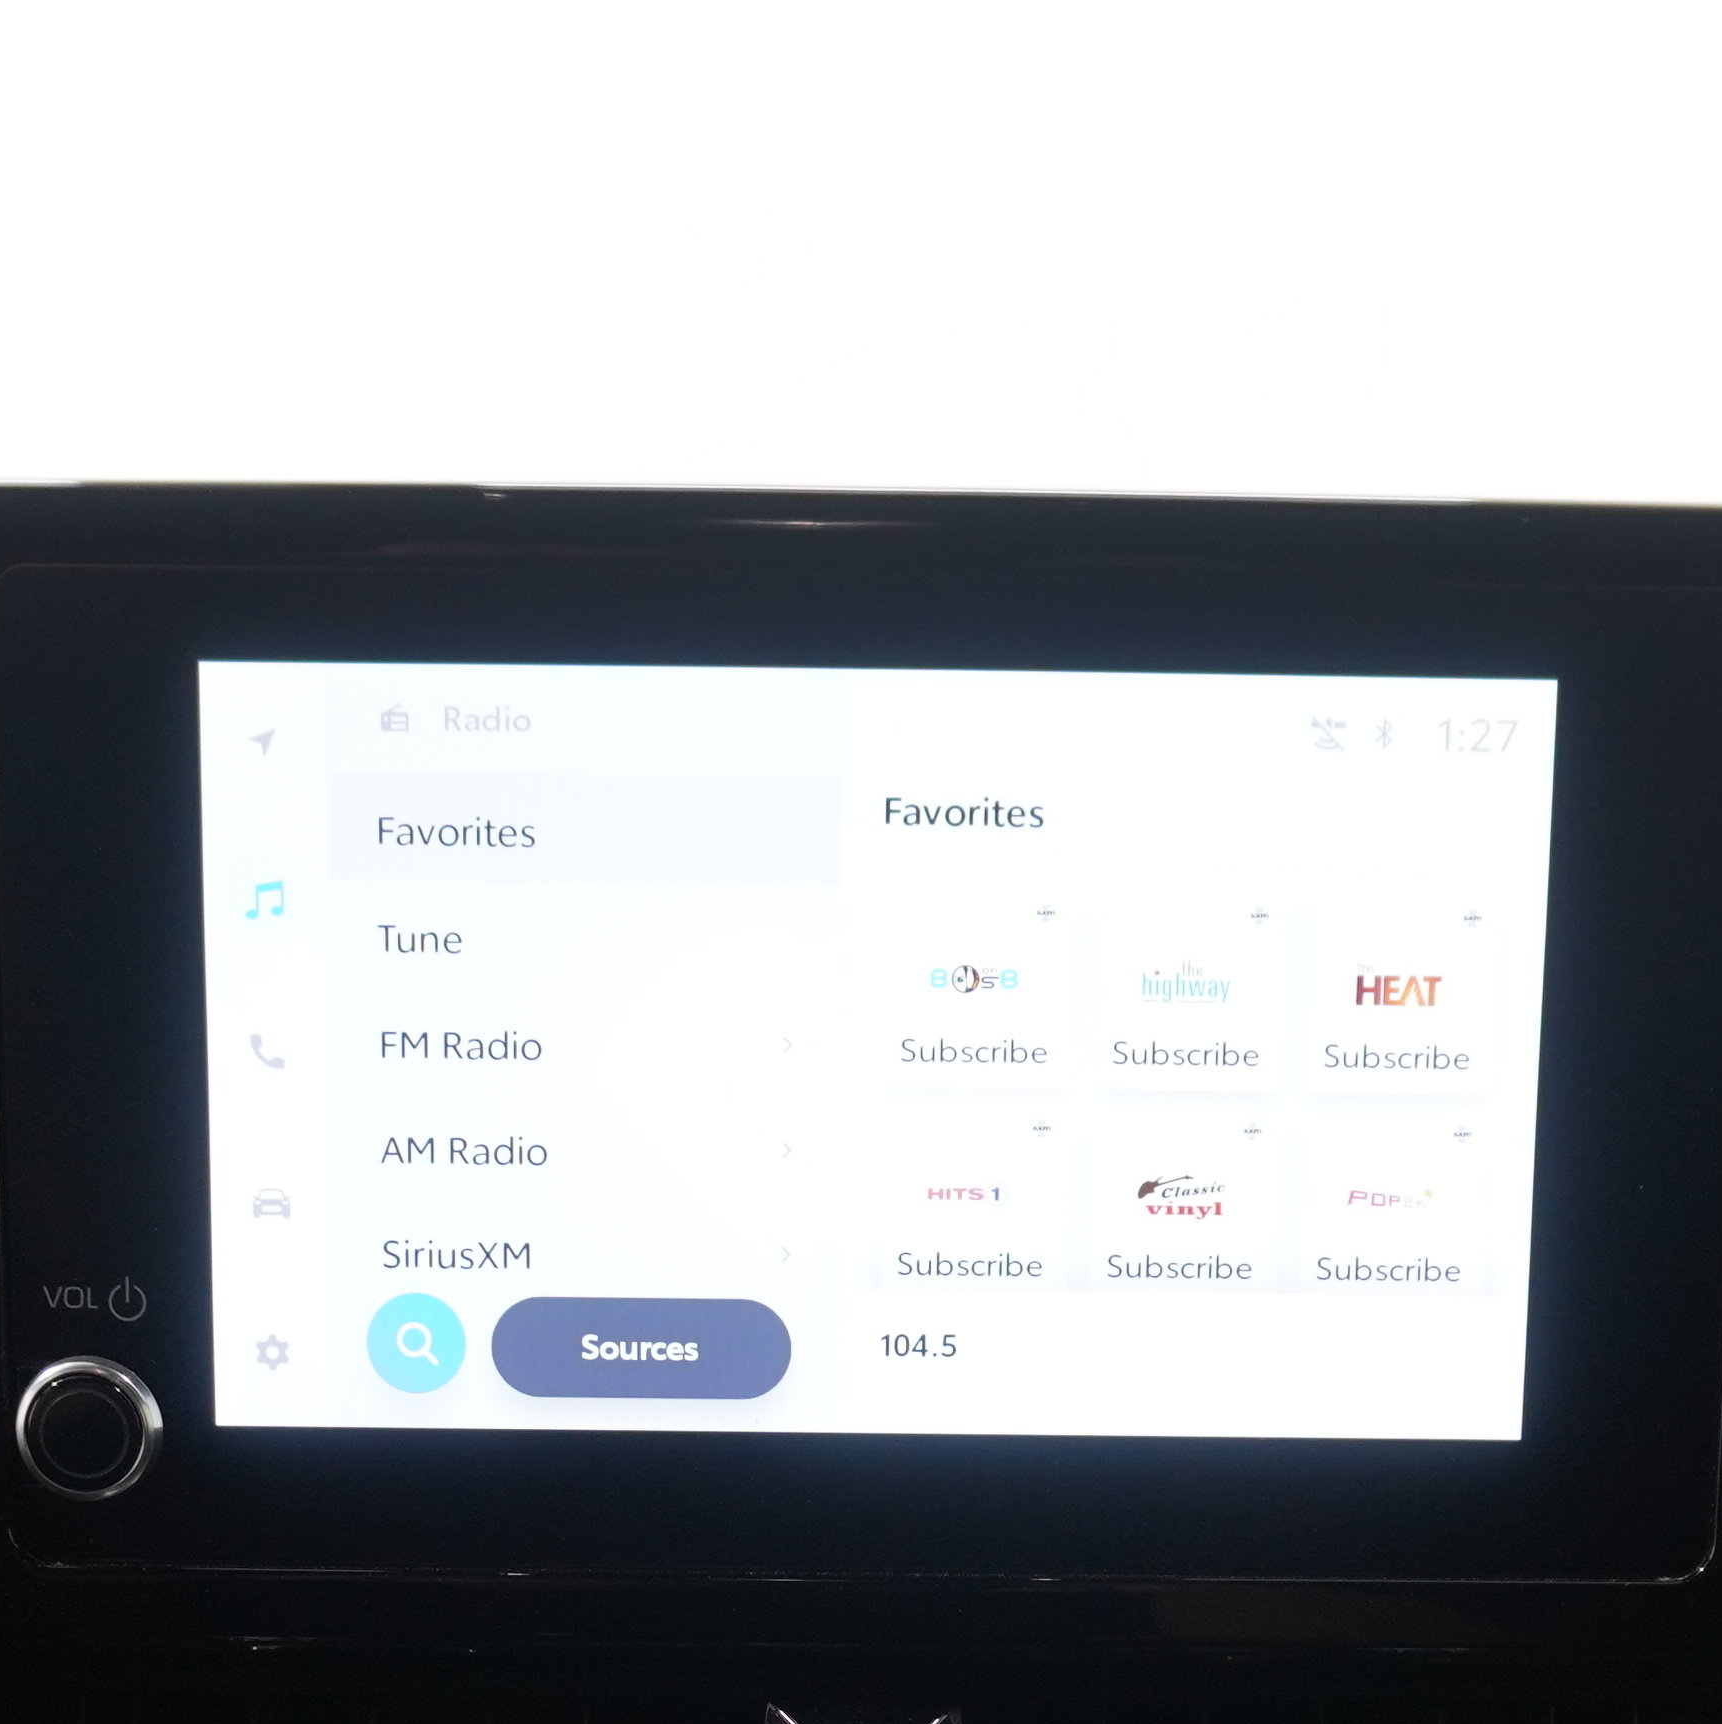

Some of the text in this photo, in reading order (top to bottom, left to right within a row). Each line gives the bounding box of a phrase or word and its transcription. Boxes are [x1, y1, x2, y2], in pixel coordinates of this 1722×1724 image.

[442, 705, 532, 734] Radio
[1438, 717, 1518, 753] 1:27
[885, 797, 1044, 828] Favorites
[377, 816, 536, 848] Favorites
[378, 924, 463, 954] Tune
[1142, 970, 1231, 1004] highway
[1355, 974, 1443, 1007] HEAT
[380, 1029, 543, 1061] FM Radio
[900, 1038, 1048, 1065] Subscribe
[1112, 1041, 1260, 1068] Subscribe
[1323, 1044, 1470, 1072] Subscribe
[381, 1135, 549, 1167] AM Radio
[927, 1186, 1001, 1201] HITS 1
[1160, 1180, 1227, 1199] Classic
[1145, 1200, 1223, 1220] vinyl
[382, 1239, 532, 1270] SiriusXM
[897, 1252, 1043, 1279] Subscribe
[1107, 1254, 1253, 1282] Subscribe
[1317, 1257, 1461, 1284] Subscribe
[43, 1285, 98, 1310] VOL
[581, 1333, 699, 1362] Sources
[880, 1333, 957, 1359] 104.5
